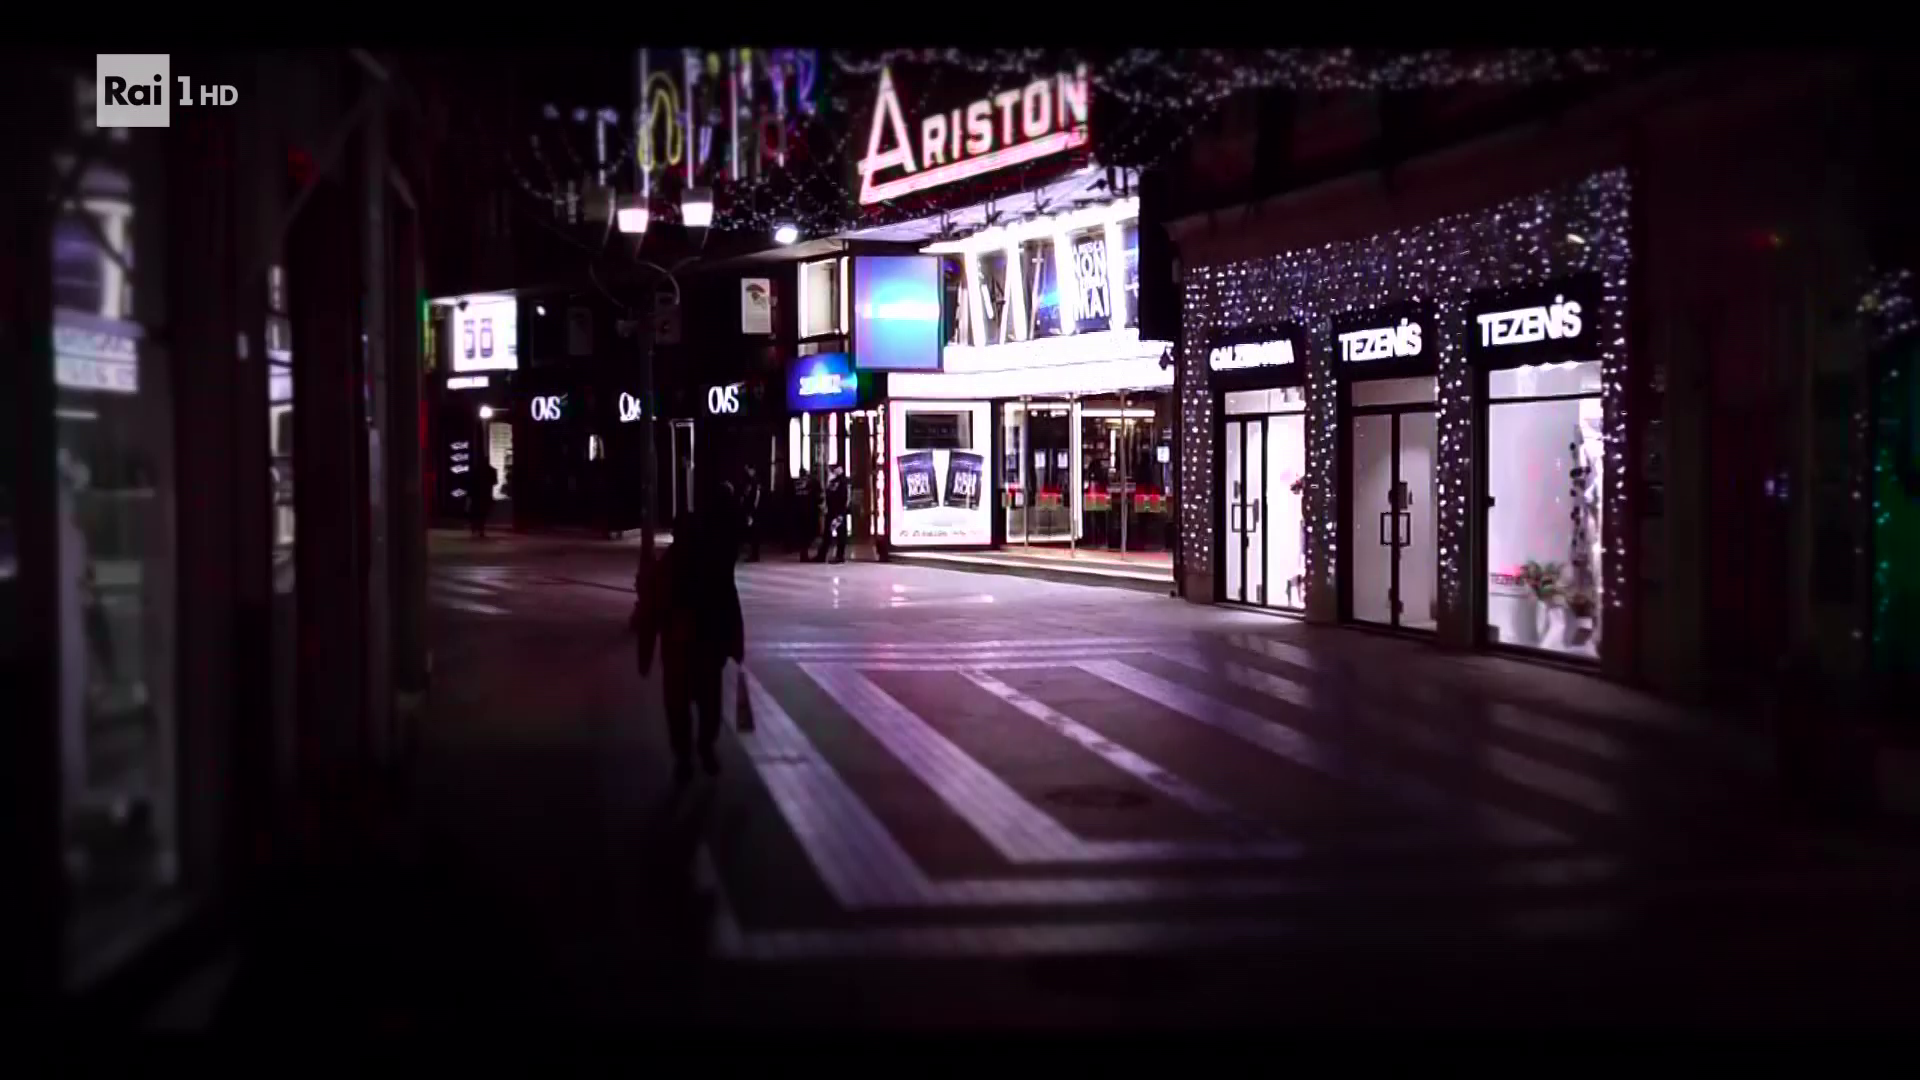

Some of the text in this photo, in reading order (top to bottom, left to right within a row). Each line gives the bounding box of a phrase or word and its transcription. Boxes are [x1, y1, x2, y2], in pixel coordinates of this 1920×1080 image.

[857, 64, 1089, 205] ARISTON
[1339, 318, 1422, 362] TEZENIS
[1477, 294, 1582, 348] TEZENIS
[531, 396, 560, 421] OVS
[708, 386, 739, 414] OVS
